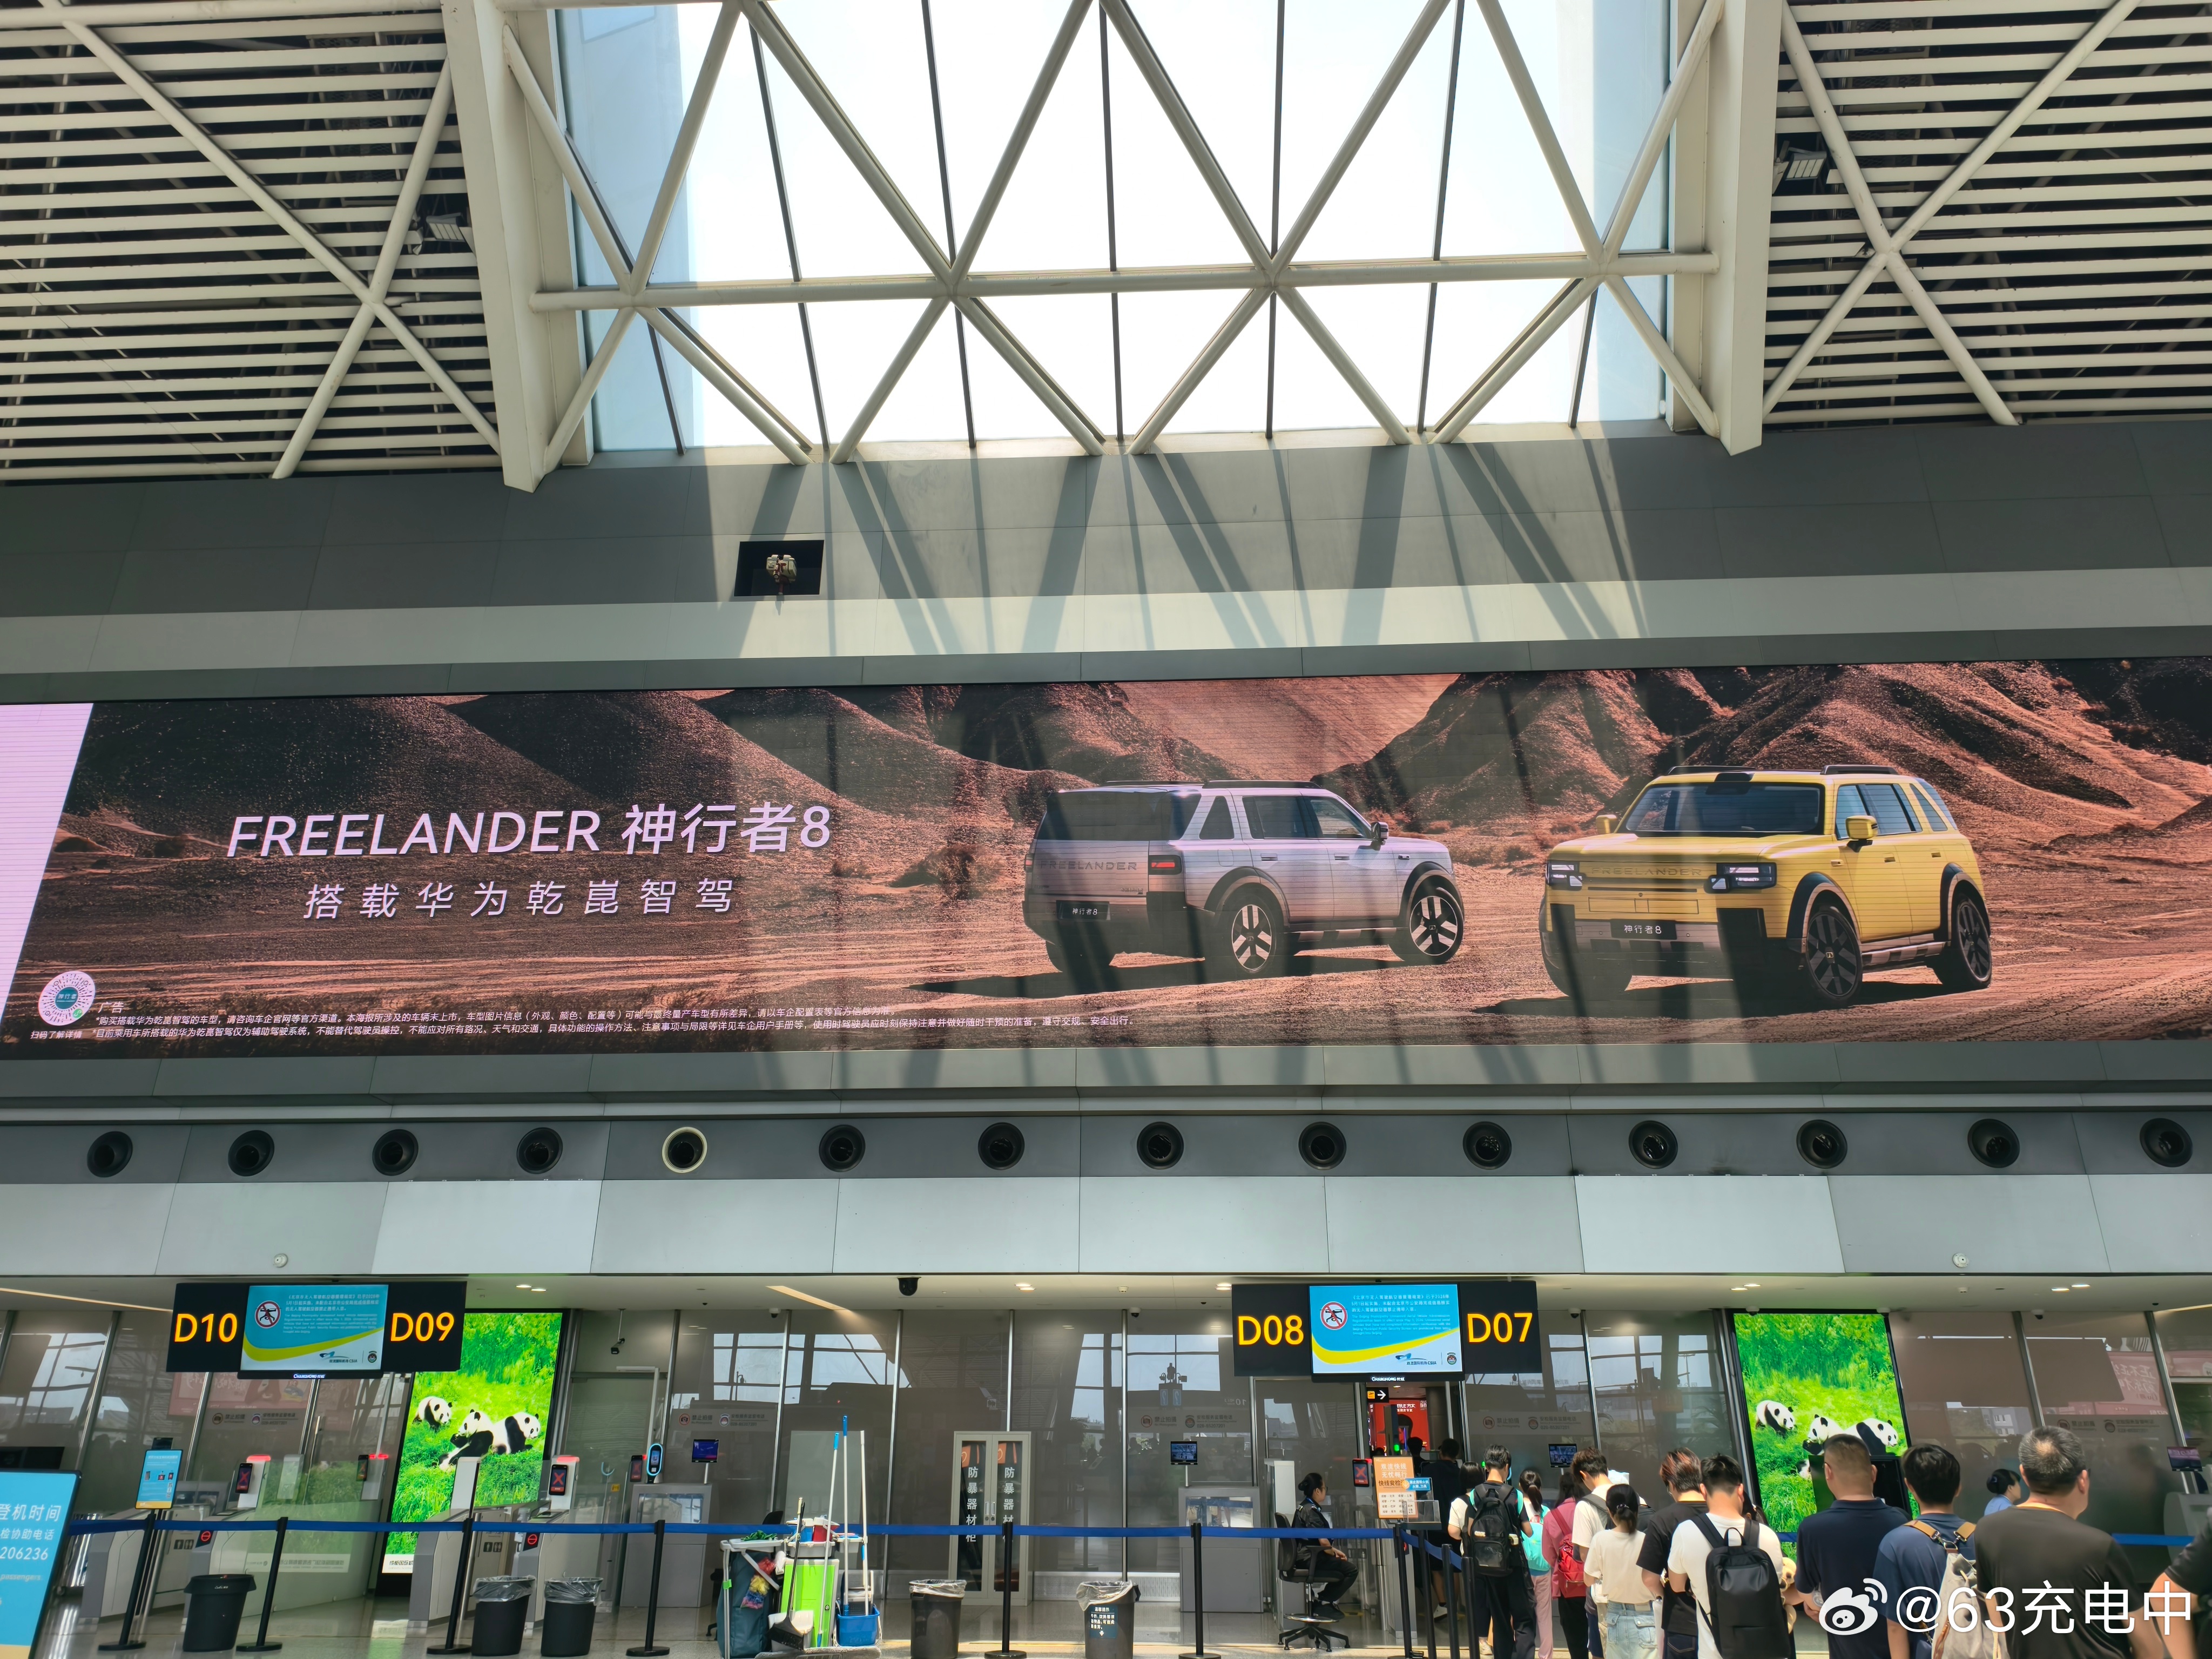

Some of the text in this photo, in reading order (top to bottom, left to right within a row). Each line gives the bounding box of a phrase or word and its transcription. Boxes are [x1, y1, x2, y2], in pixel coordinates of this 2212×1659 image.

[227, 802, 831, 857] FREELANDER 神行者8
[1040, 860, 1137, 870] FREELANDER
[1591, 867, 1702, 876] FREELANDER
[304, 879, 734, 920] 搭载华为乾崑智驾
[1624, 925, 1662, 934] 神行者8
[98, 1001, 124, 1014] 广告
[30, 1030, 83, 1040] 扫码了解详情
[174, 1313, 238, 1342] D10
[390, 1312, 454, 1342] D09
[1238, 1315, 1304, 1346] D08
[1467, 1312, 1533, 1344] D07
[0, 1503, 62, 1522] 登机时间
[1003, 1467, 1015, 1542] 防暴器材
[0, 1528, 55, 1540] 检协助电话
[0, 1546, 49, 1560] 206236
